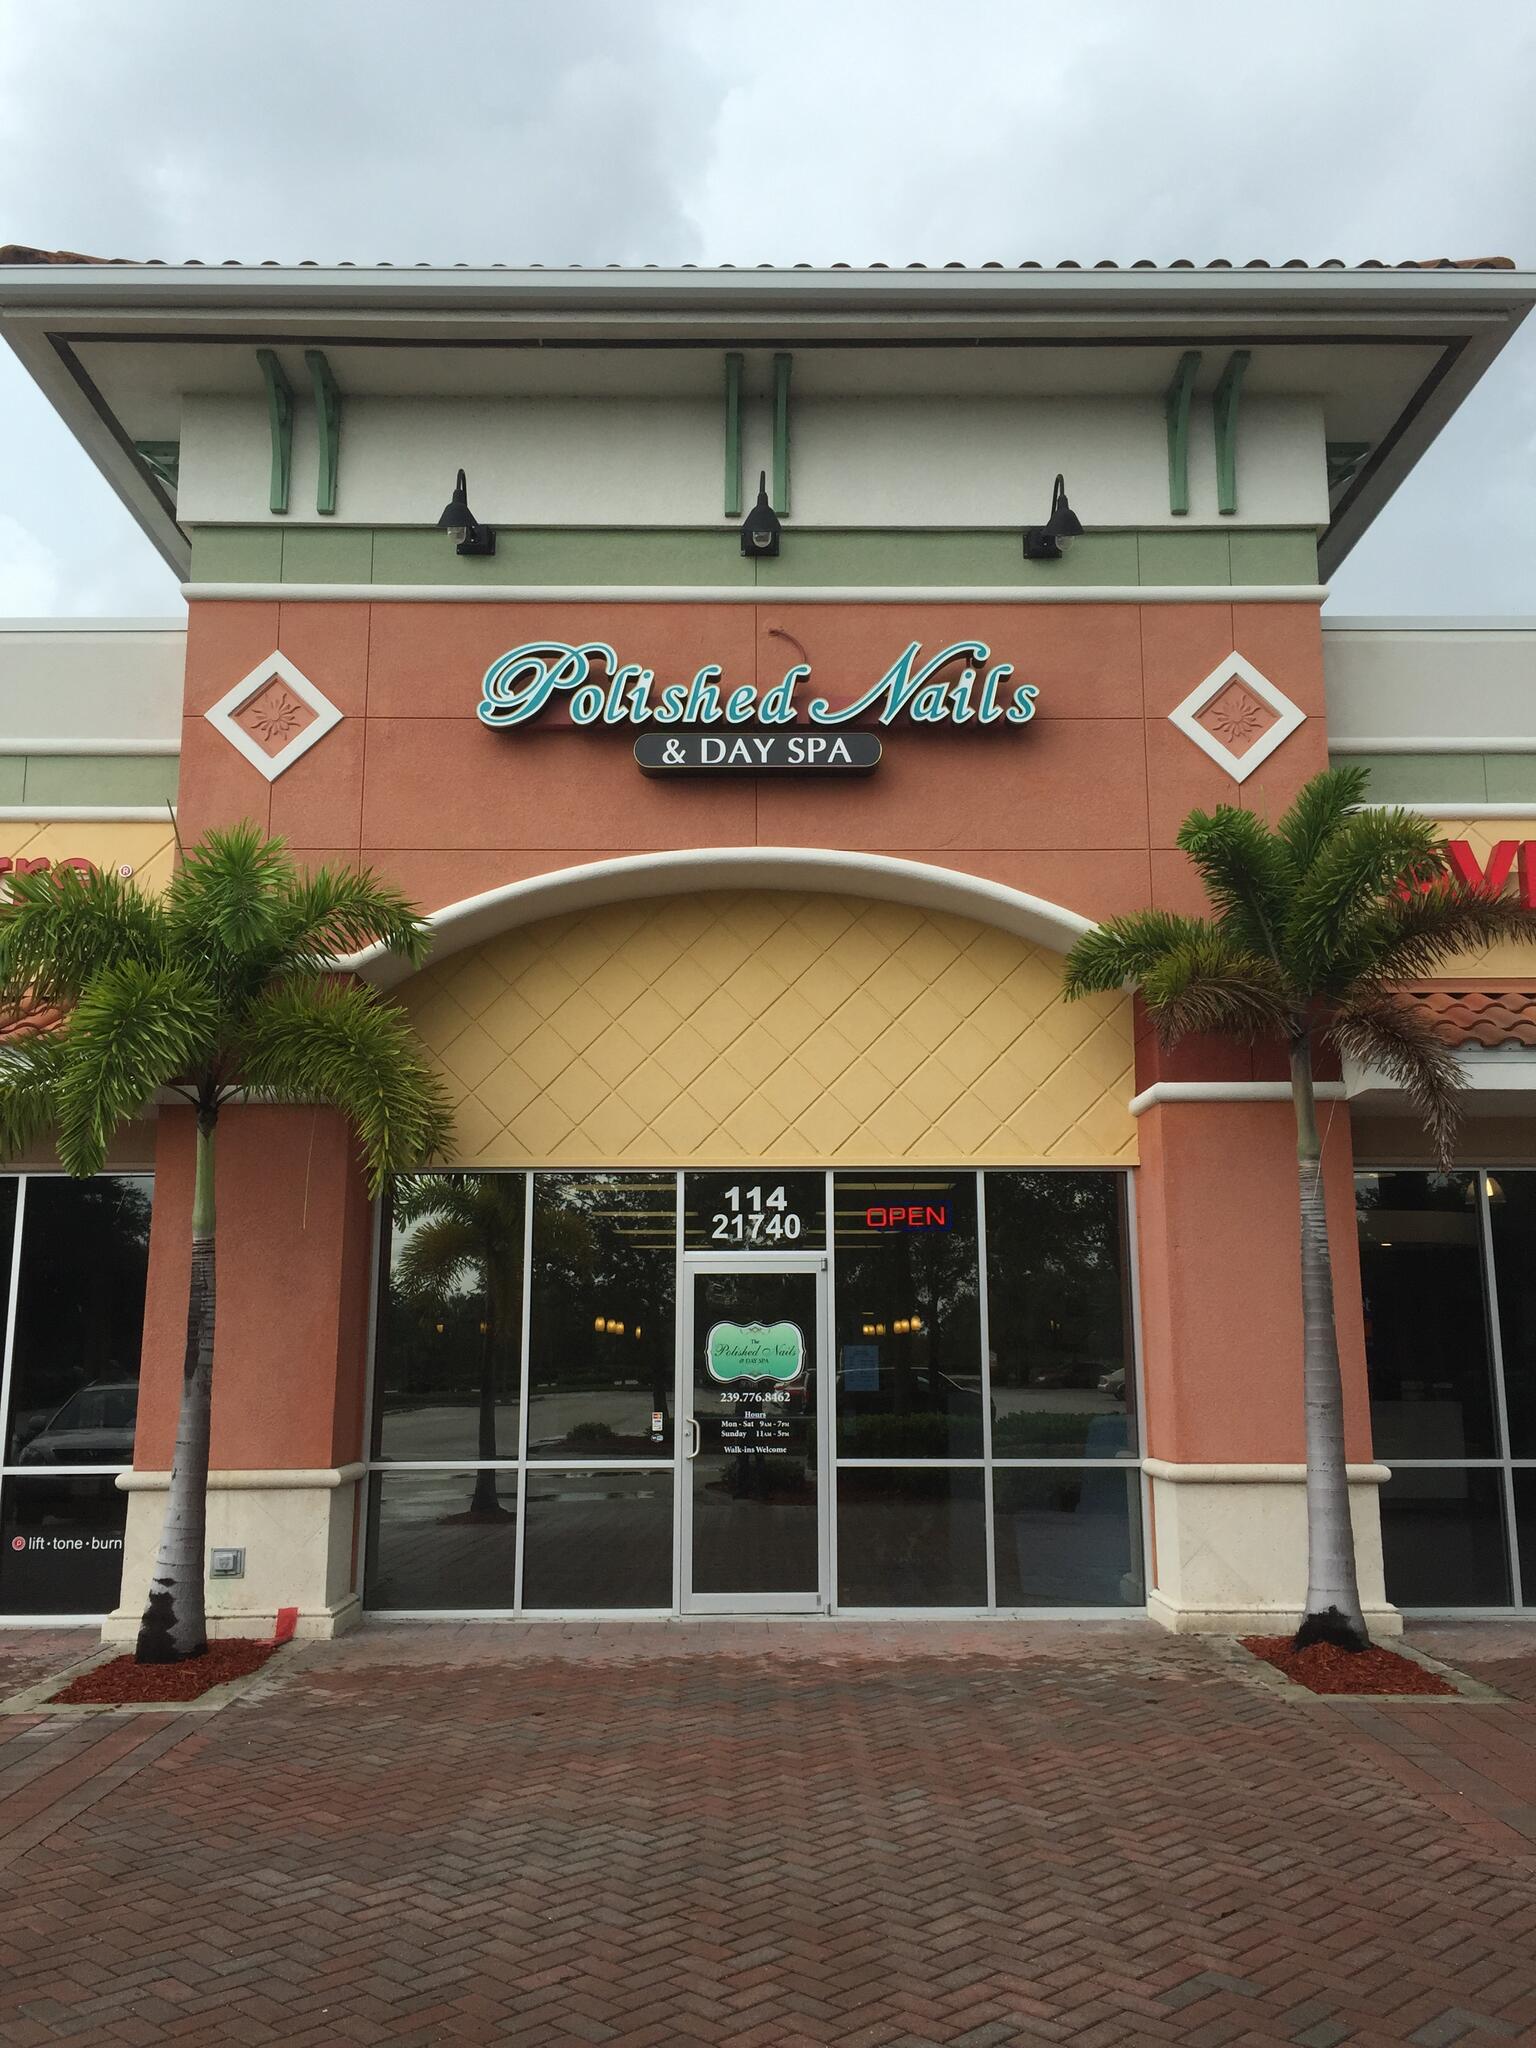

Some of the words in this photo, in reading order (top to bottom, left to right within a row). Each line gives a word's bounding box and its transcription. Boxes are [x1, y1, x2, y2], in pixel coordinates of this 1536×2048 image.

[477, 640, 812, 726] Polished
[807, 640, 1041, 725] Nails
[661, 739, 687, 765] &
[701, 739, 775, 764] DAY
[787, 739, 853, 764] SPA
[724, 1186, 788, 1212] 114
[865, 1206, 946, 1228] OPEN
[711, 1213, 801, 1239] 21740
[714, 1343, 761, 1357] Polished
[762, 1343, 797, 1357] Nails
[720, 1392, 791, 1402] 239.776.8462
[744, 1411, 767, 1419] Hours
[721, 1420, 738, 1428] Mon
[742, 1420, 754, 1428] Sat
[720, 1430, 748, 1439] Sunday
[724, 1446, 755, 1454] Walk-ins
[755, 1446, 787, 1454] Welcome
[91, 1536, 123, 1550] burn
